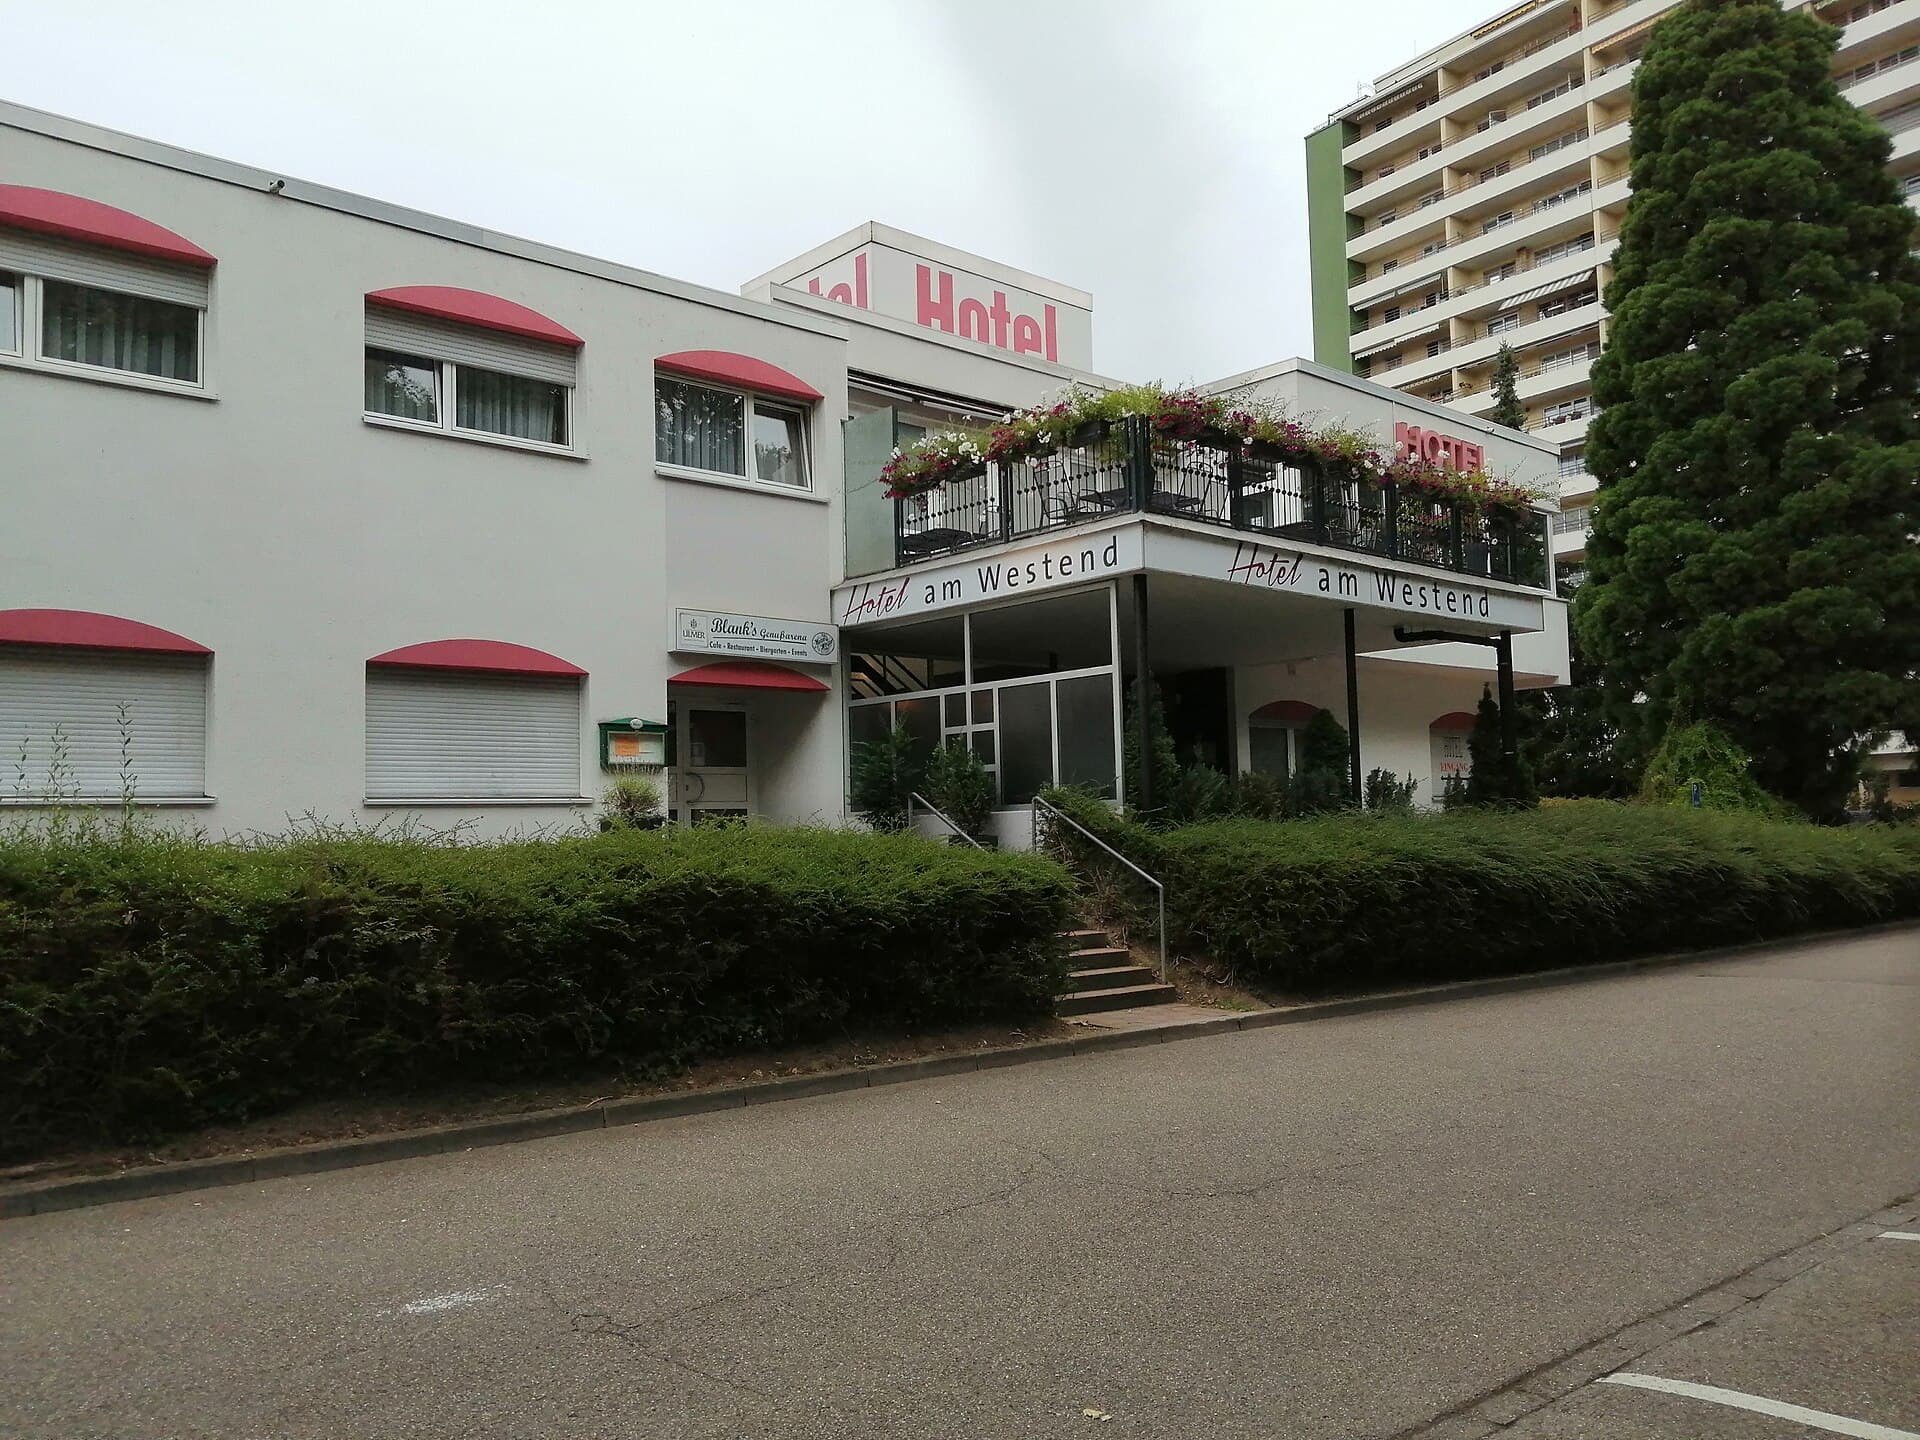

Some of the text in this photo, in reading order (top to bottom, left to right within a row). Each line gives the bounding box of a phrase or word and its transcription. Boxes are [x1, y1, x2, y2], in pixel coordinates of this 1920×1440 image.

[916, 263, 1058, 364] Hotel
[842, 535, 1119, 624] Hotel am Westend
[1227, 542, 1490, 618] Hotel am Westend
[711, 617, 757, 637] Blank's
[727, 642, 755, 652] Restaurant
